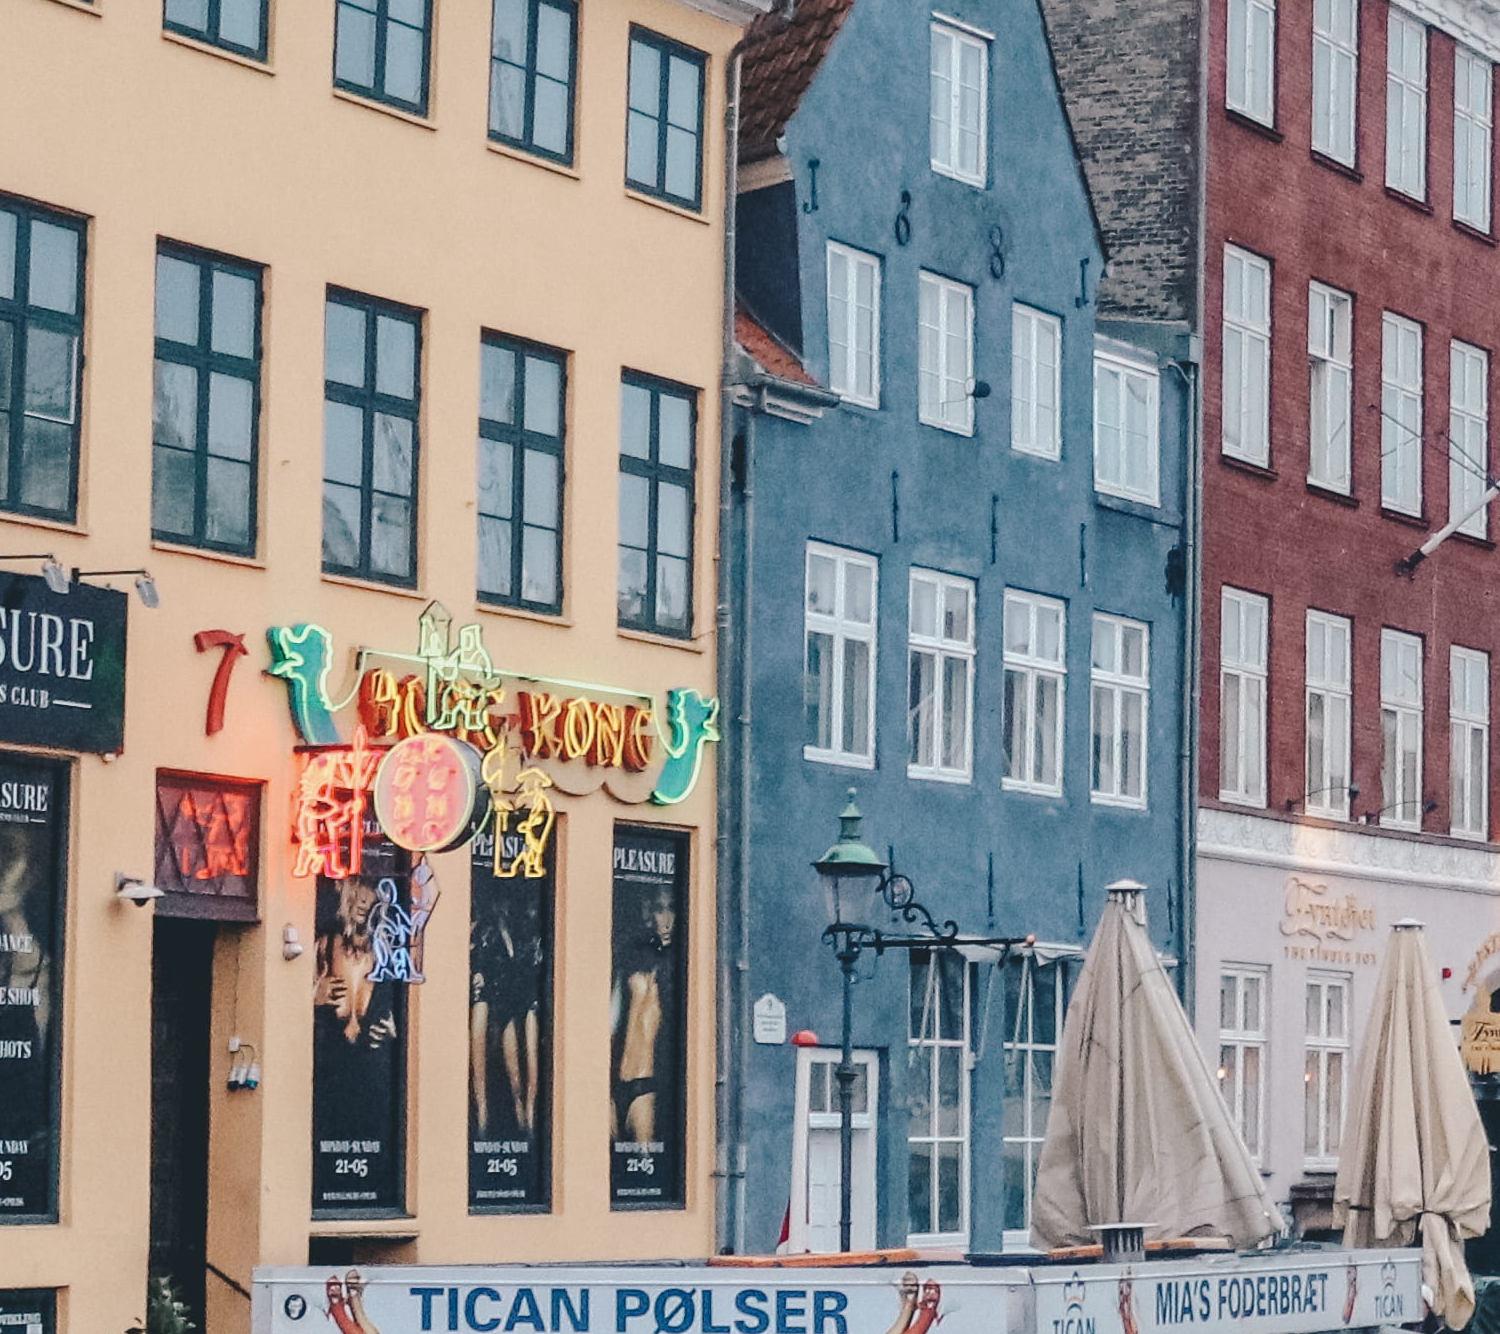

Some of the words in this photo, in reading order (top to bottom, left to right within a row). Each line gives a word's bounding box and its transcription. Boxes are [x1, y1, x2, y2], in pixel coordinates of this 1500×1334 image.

[10, 686, 50, 709] CLUB
[613, 847, 676, 875] PLEASURE
[7, 987, 41, 1006] SHOW
[335, 1159, 368, 1177] 21-05
[487, 1158, 518, 1176] 21-05
[627, 1158, 655, 1175] 21-05
[410, 1286, 590, 1333] TICAN
[1155, 1281, 1211, 1325] MIA'S
[1218, 1273, 1329, 1319] FODERBRÆT
[1373, 1294, 1404, 1320] TICAN
